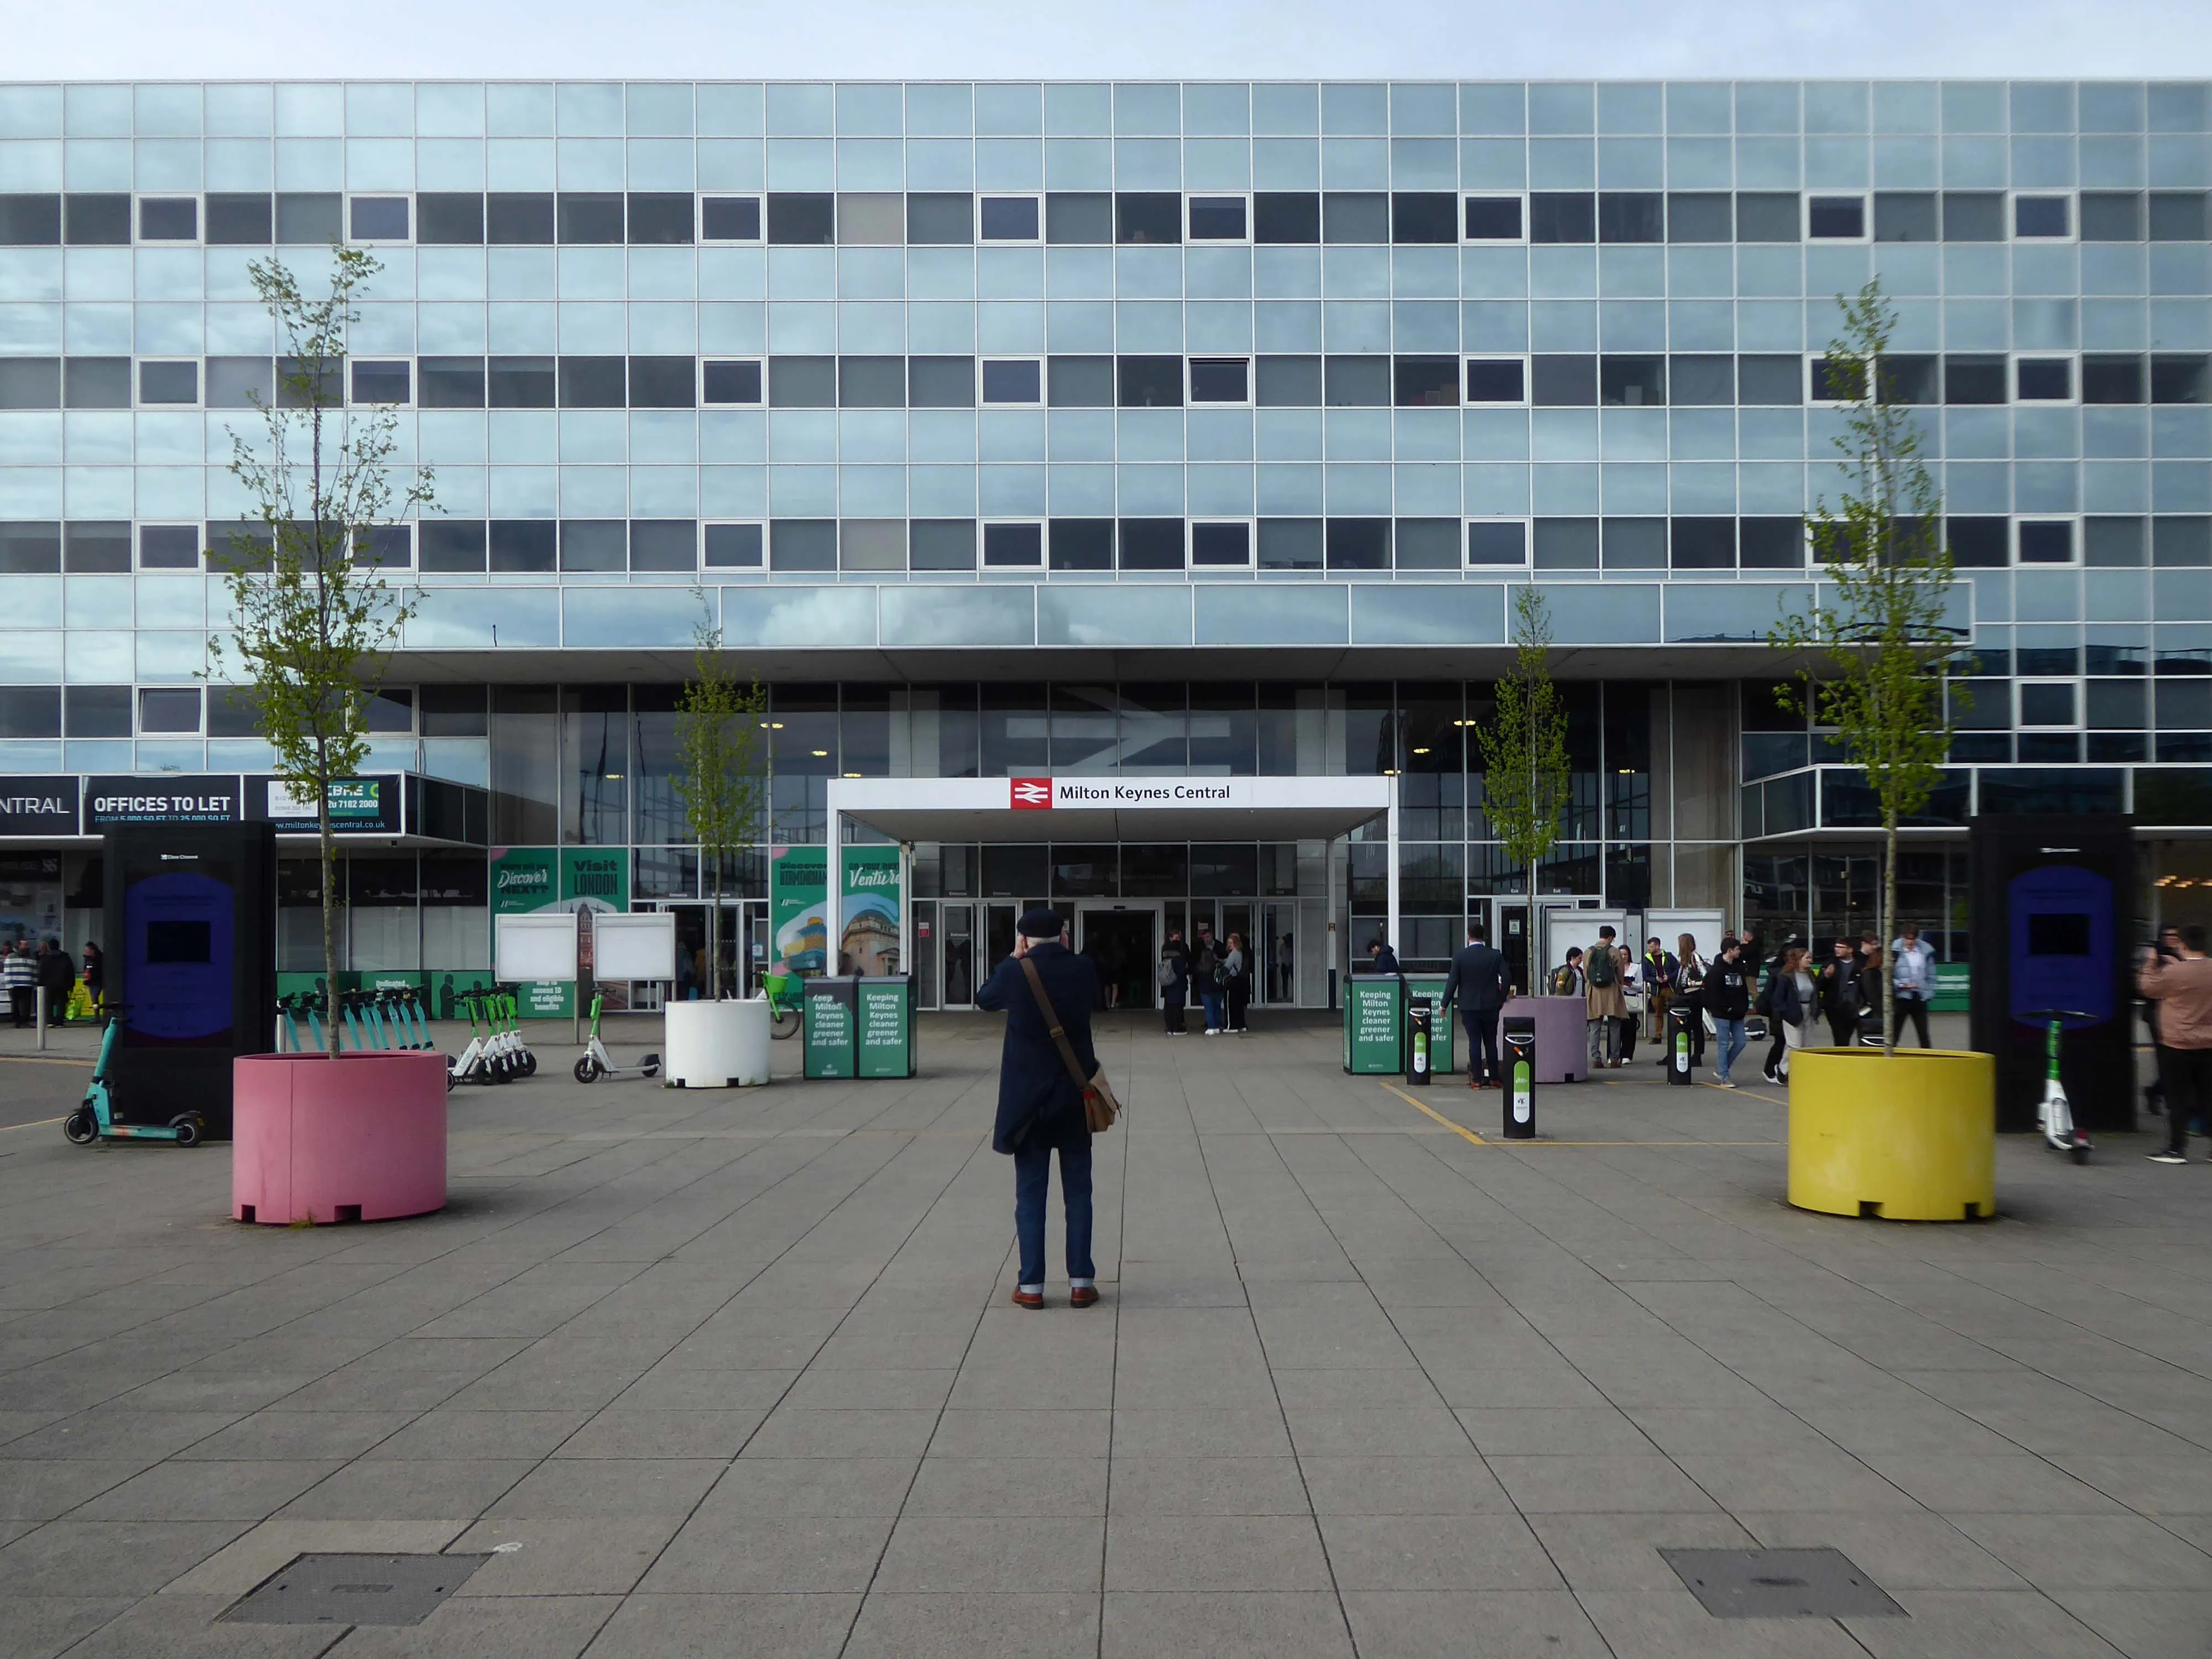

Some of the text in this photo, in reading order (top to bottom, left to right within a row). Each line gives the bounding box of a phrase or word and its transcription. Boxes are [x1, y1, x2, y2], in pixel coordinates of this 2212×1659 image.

[1060, 785, 1230, 801] Milton Keynes Central
[94, 796, 231, 812] OFFICES TO LET
[574, 860, 618, 871] Visit
[498, 869, 547, 888] Discover
[850, 867, 900, 888] Venture
[575, 874, 618, 895] LONDON
[867, 993, 899, 1002] Keeping
[1360, 990, 1391, 999] Keeping
[816, 1013, 844, 1021] Keynes
[869, 1011, 898, 1020] Keynes
[1363, 1008, 1390, 1017] Keynes
